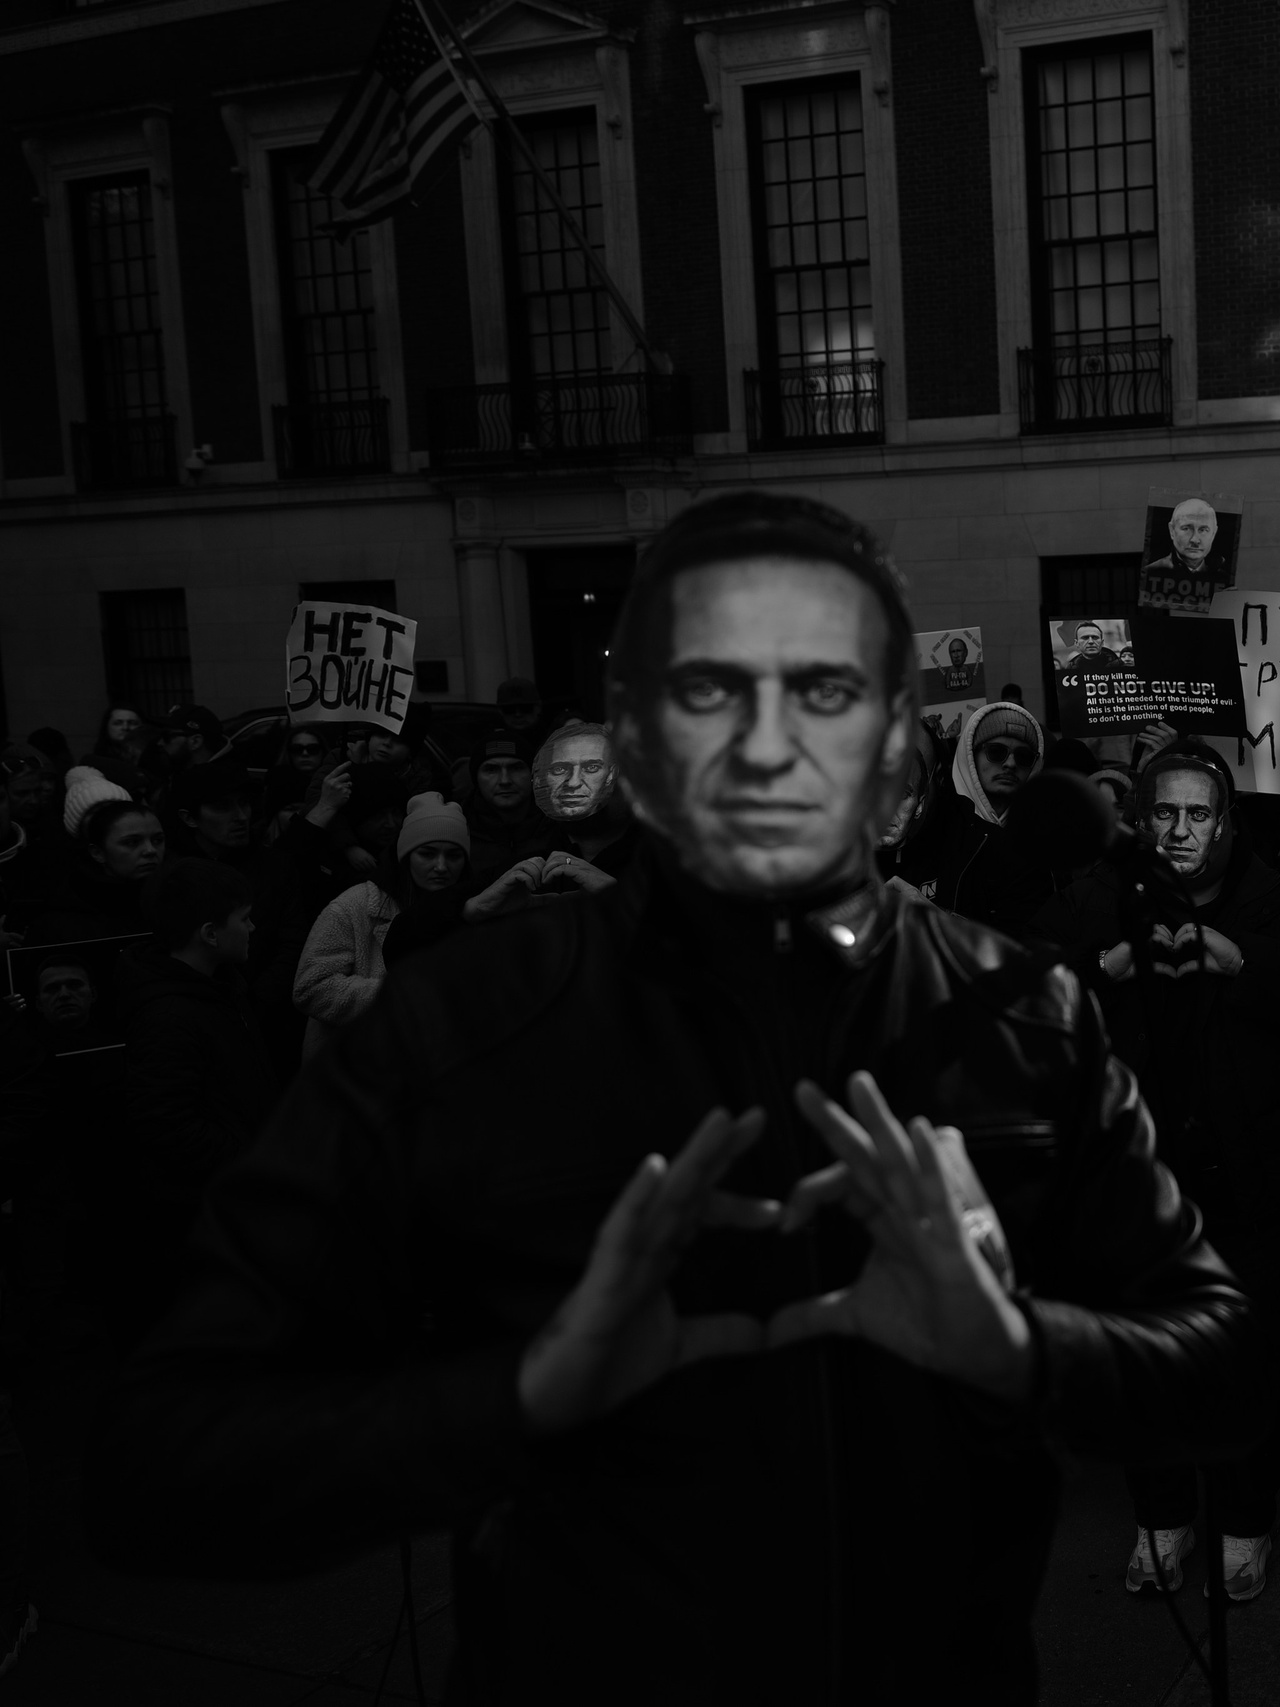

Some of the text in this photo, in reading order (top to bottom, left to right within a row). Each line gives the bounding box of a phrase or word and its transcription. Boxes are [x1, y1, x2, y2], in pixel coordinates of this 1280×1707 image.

[1138, 590, 1212, 612] РОССИ
[303, 610, 406, 660] НЕТ
[1092, 673, 1110, 681] they
[1111, 672, 1124, 680] kill
[1085, 681, 1217, 696] DO NOT GIVE UP!
[1086, 697, 1097, 706] All
[1098, 697, 1115, 705] that
[1117, 696, 1124, 704] is
[1125, 695, 1154, 703] needed
[1167, 695, 1180, 703] the
[1182, 696, 1210, 706] triumph
[1211, 697, 1219, 705] of
[1220, 698, 1233, 706] evil
[1088, 706, 1103, 714] this
[1113, 705, 1126, 713] the
[1127, 703, 1158, 712] inaction
[1160, 703, 1168, 711] of
[1170, 704, 1188, 713] good
[1088, 716, 1098, 724] so
[1121, 712, 1131, 721] do
